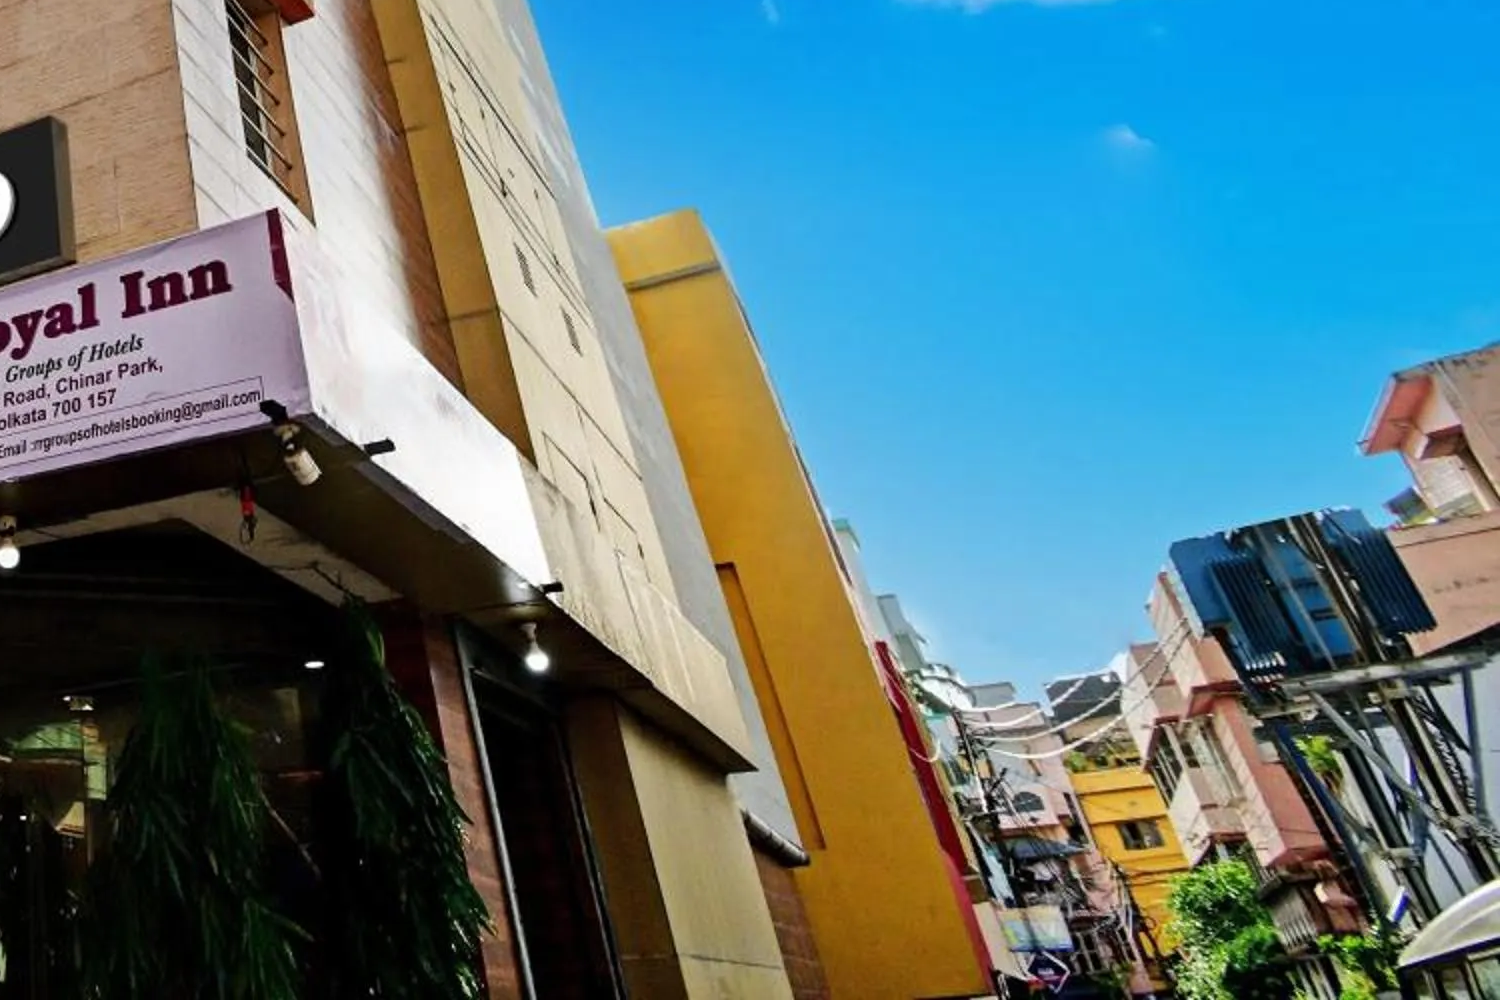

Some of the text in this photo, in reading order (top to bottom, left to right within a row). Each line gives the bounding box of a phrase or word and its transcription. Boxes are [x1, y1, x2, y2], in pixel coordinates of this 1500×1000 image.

[119, 258, 232, 321] Inn
[3, 384, 51, 408] Road,
[55, 367, 112, 395] Chinar
[117, 357, 164, 379] Park,
[6, 356, 63, 383] Groups
[68, 348, 84, 372] of
[88, 333, 144, 362] Hotels
[52, 398, 82, 418] 700
[88, 388, 117, 409] 157
